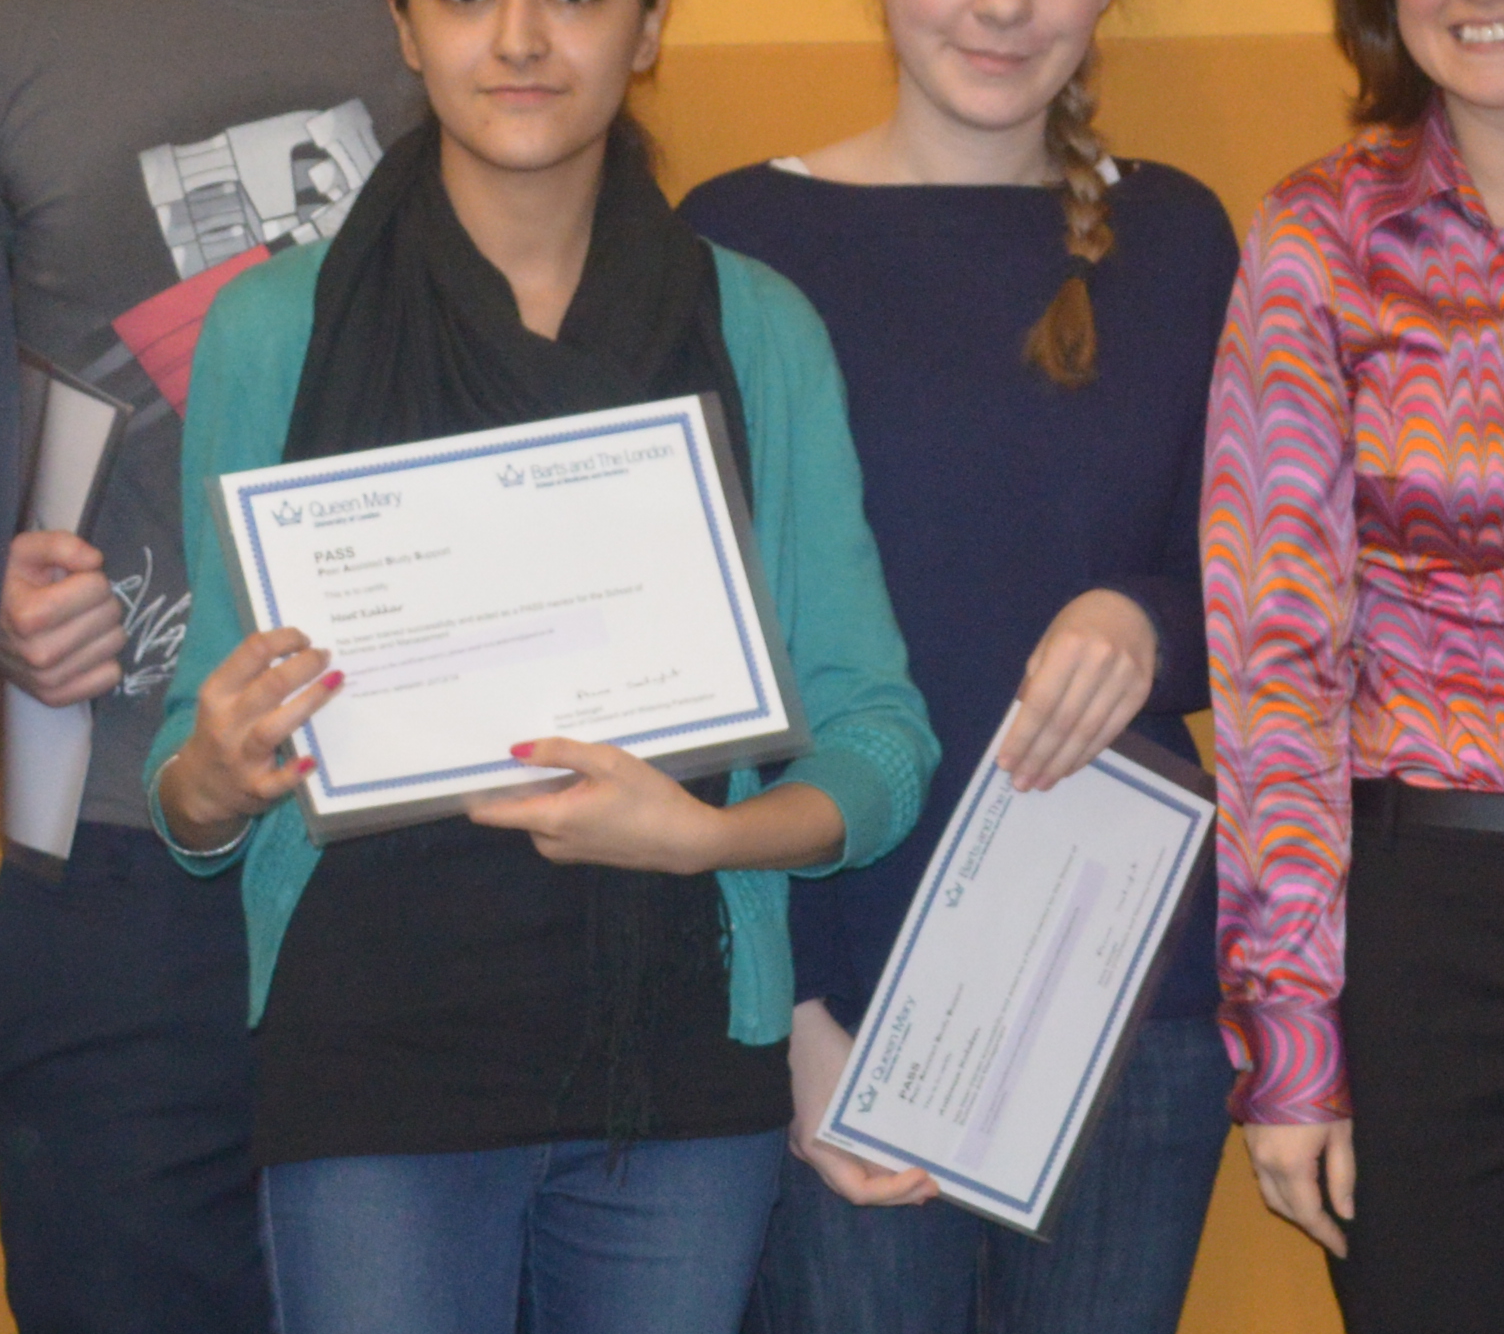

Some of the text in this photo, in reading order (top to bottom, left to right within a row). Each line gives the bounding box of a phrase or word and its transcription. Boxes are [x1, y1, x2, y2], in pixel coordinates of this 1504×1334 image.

[528, 440, 676, 480] Barts and The London
[306, 486, 406, 520] Queen Mary
[312, 545, 357, 564] PASS
[956, 789, 1005, 880] Barts and The
[869, 993, 918, 1082] Queen Mary
[897, 1060, 921, 1100] PASS
